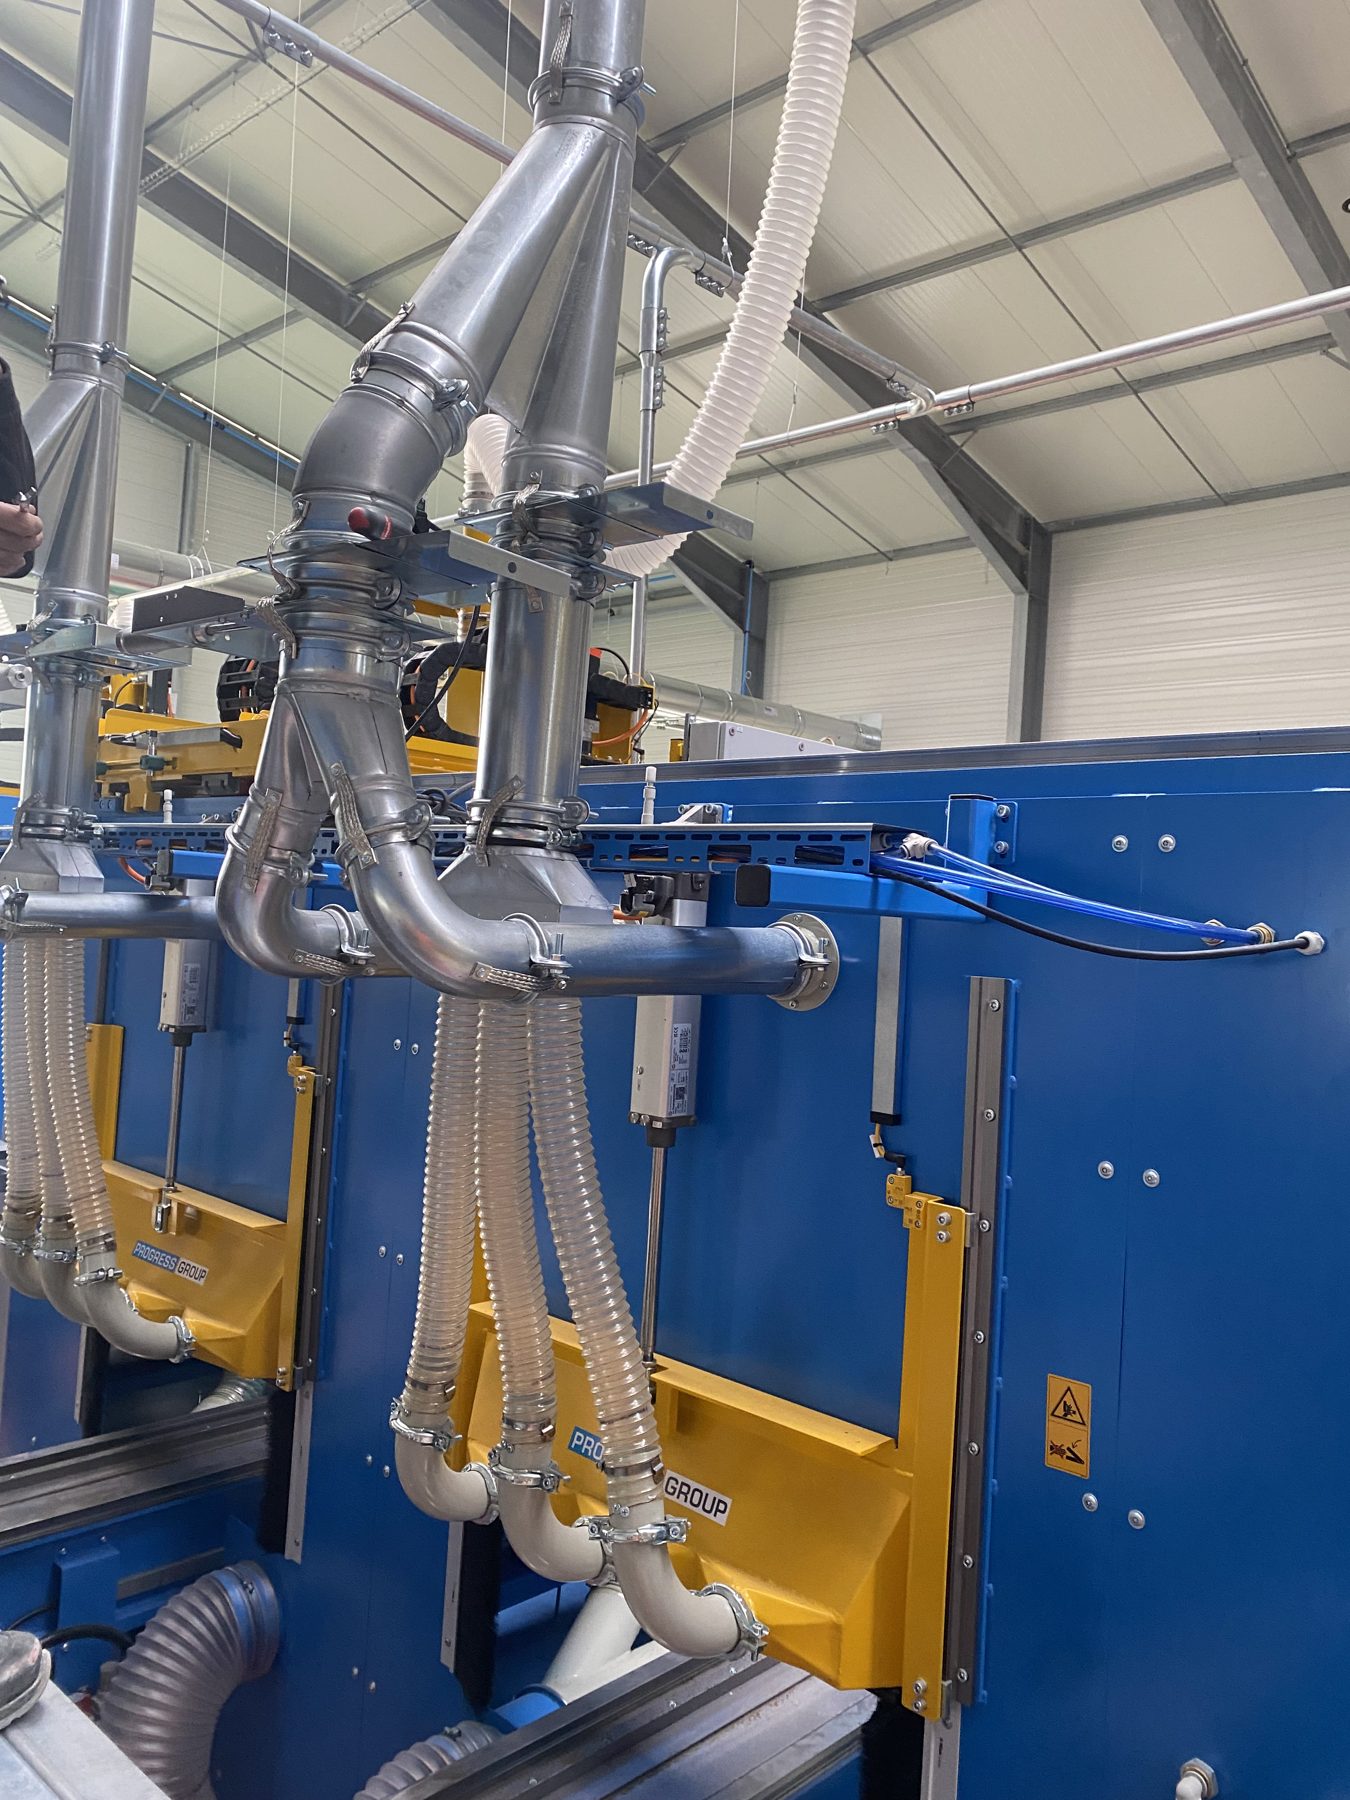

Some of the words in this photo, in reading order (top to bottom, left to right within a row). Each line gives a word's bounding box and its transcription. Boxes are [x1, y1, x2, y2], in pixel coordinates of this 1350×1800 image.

[133, 1242, 178, 1270] PROGRESS
[177, 1261, 207, 1282] GROUP
[664, 1476, 728, 1518] GROUP
